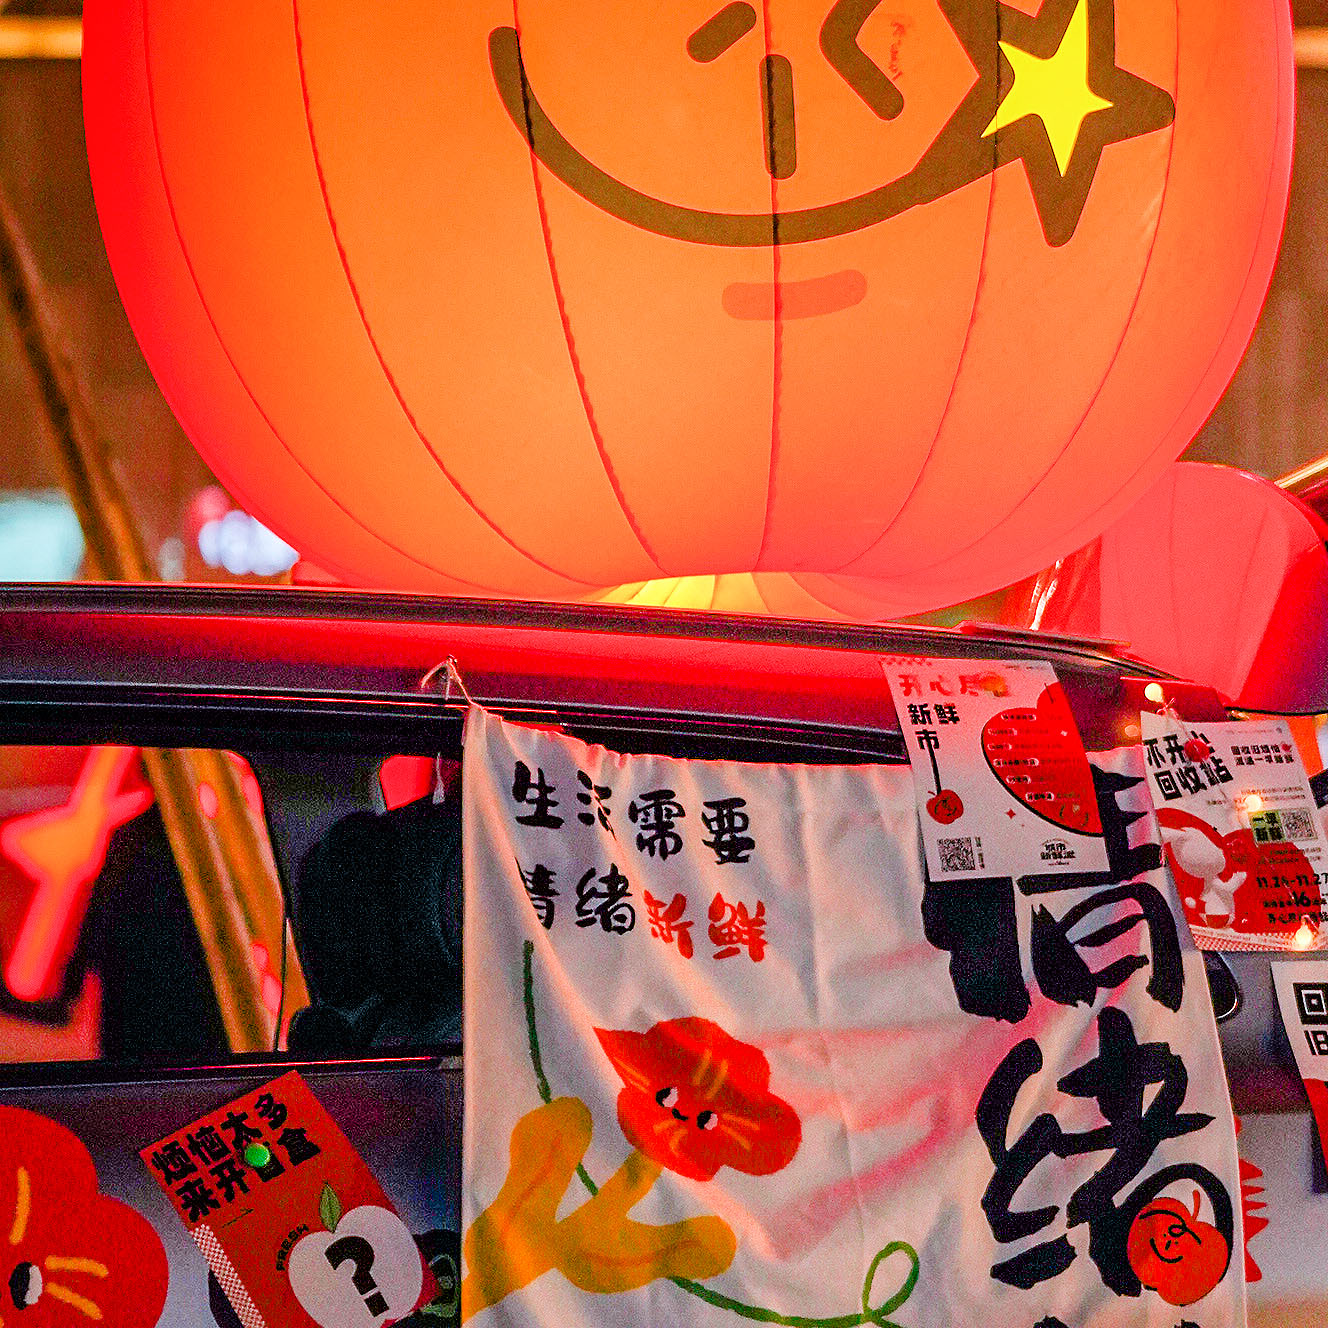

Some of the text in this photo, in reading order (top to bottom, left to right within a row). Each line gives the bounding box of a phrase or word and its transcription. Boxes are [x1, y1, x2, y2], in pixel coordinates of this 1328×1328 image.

[907, 702, 961, 725] 新鲜
[1154, 756, 1234, 800] 回收站
[151, 1092, 288, 1187] 烦恼太多
[275, 1223, 310, 1272] FRESH
